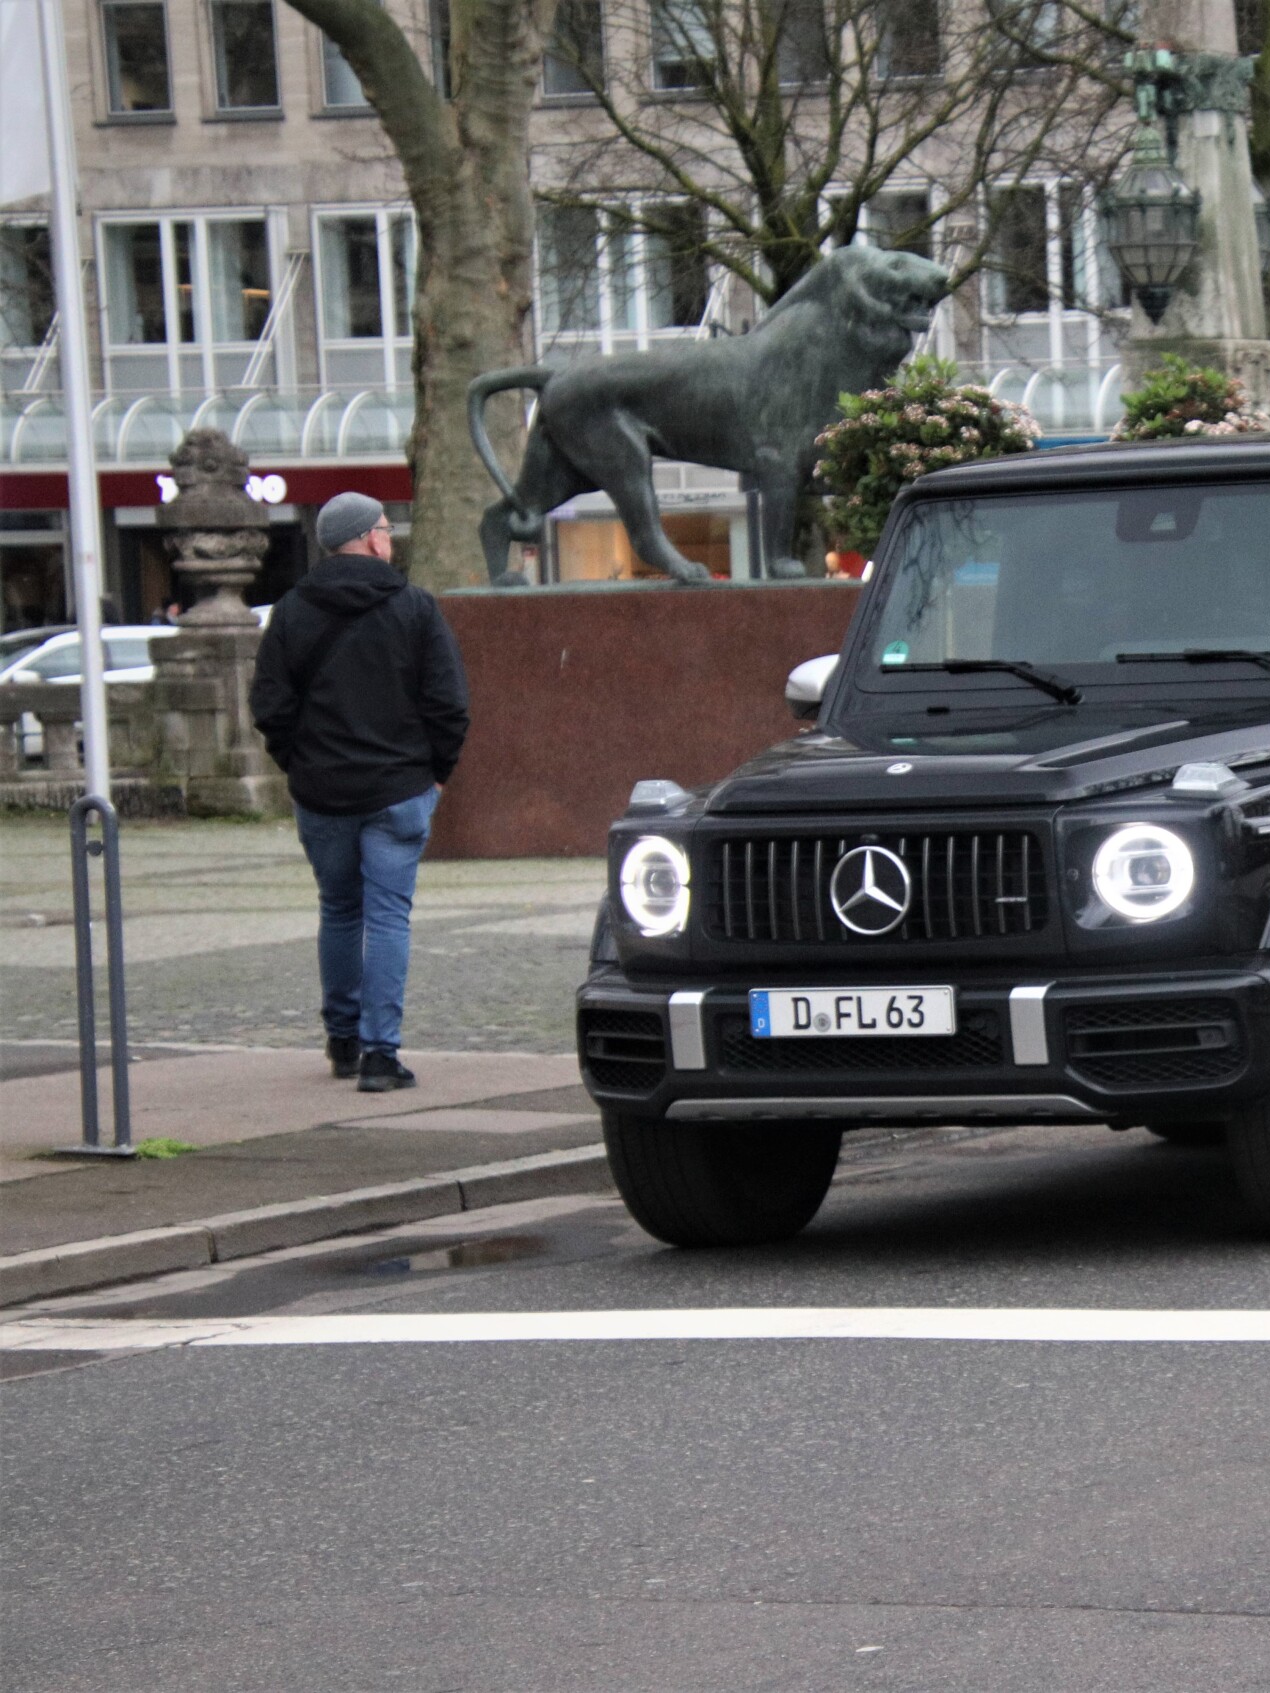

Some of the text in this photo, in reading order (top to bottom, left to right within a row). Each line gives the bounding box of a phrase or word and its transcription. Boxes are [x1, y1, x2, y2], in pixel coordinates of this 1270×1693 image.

[791, 995, 925, 1030] D FL 63
